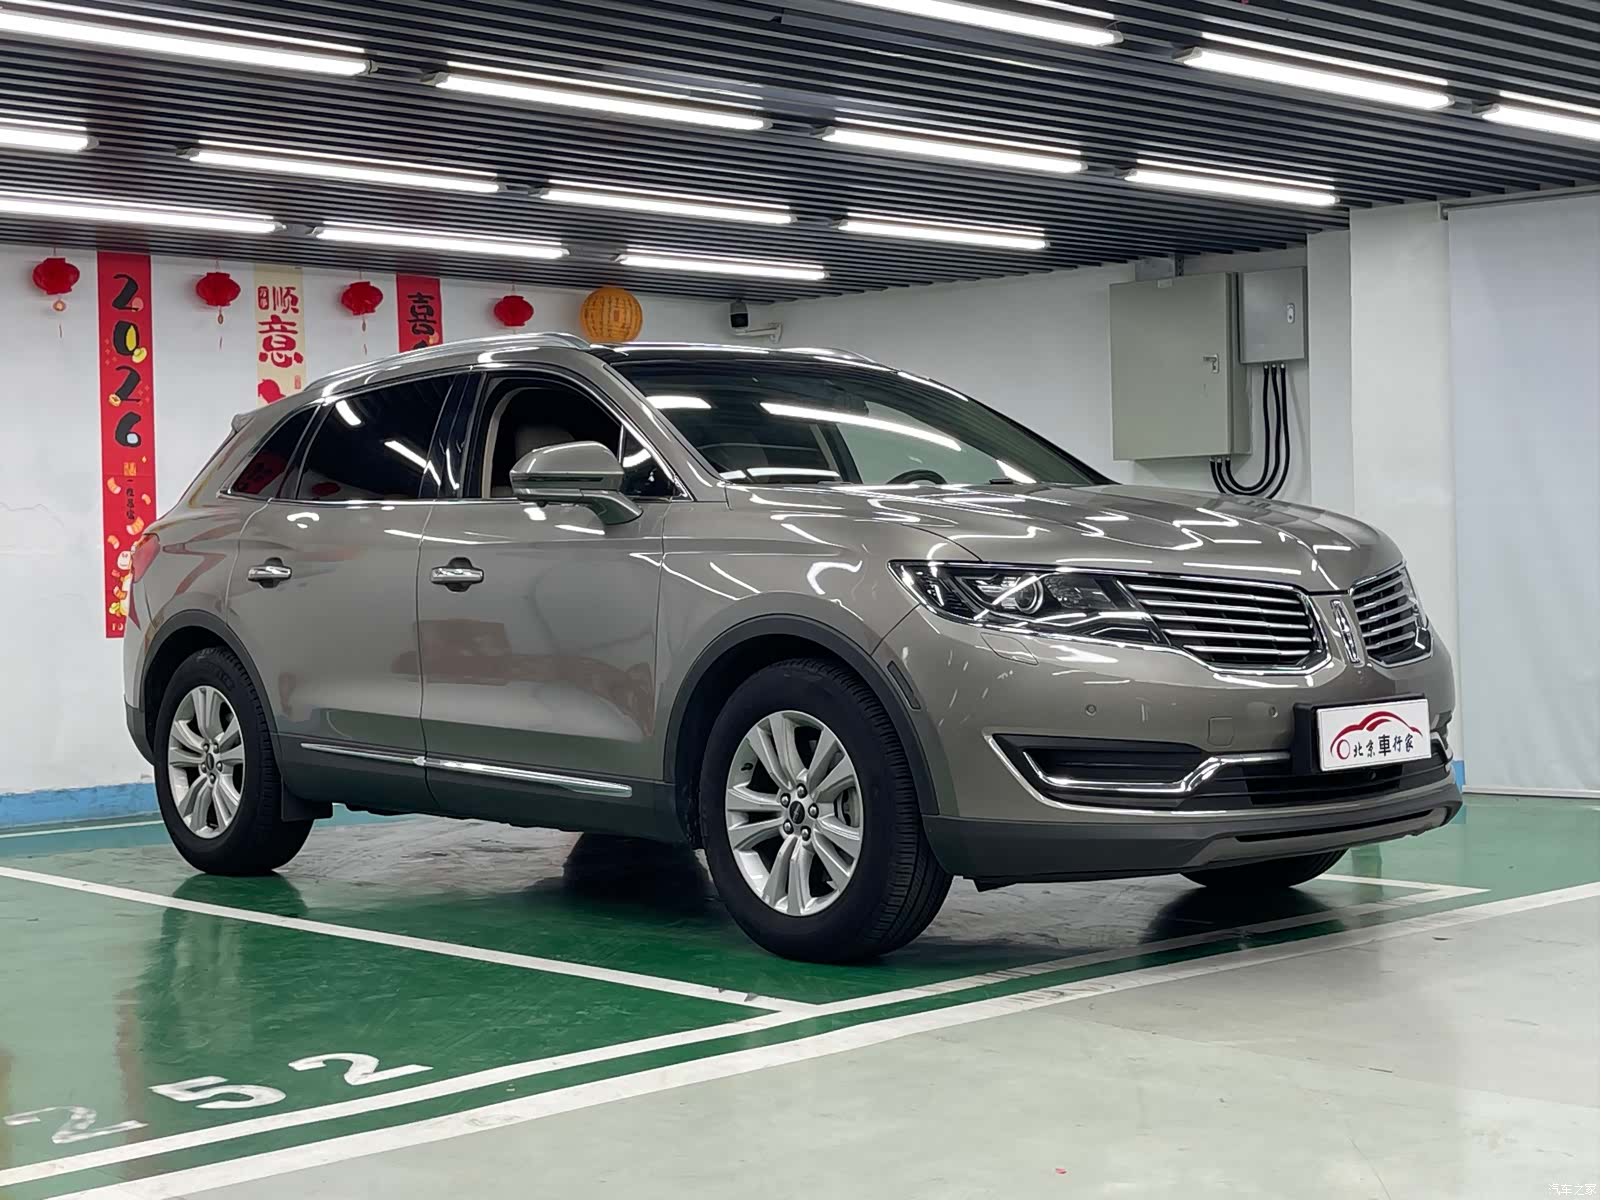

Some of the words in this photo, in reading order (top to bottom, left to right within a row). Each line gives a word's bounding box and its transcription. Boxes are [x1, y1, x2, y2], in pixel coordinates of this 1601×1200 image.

[111, 273, 142, 448] 2026
[258, 285, 304, 369] 顺意
[406, 291, 437, 350] 喜
[1353, 733, 1414, 758] 北京車行家
[3, 1052, 434, 1144] 252
